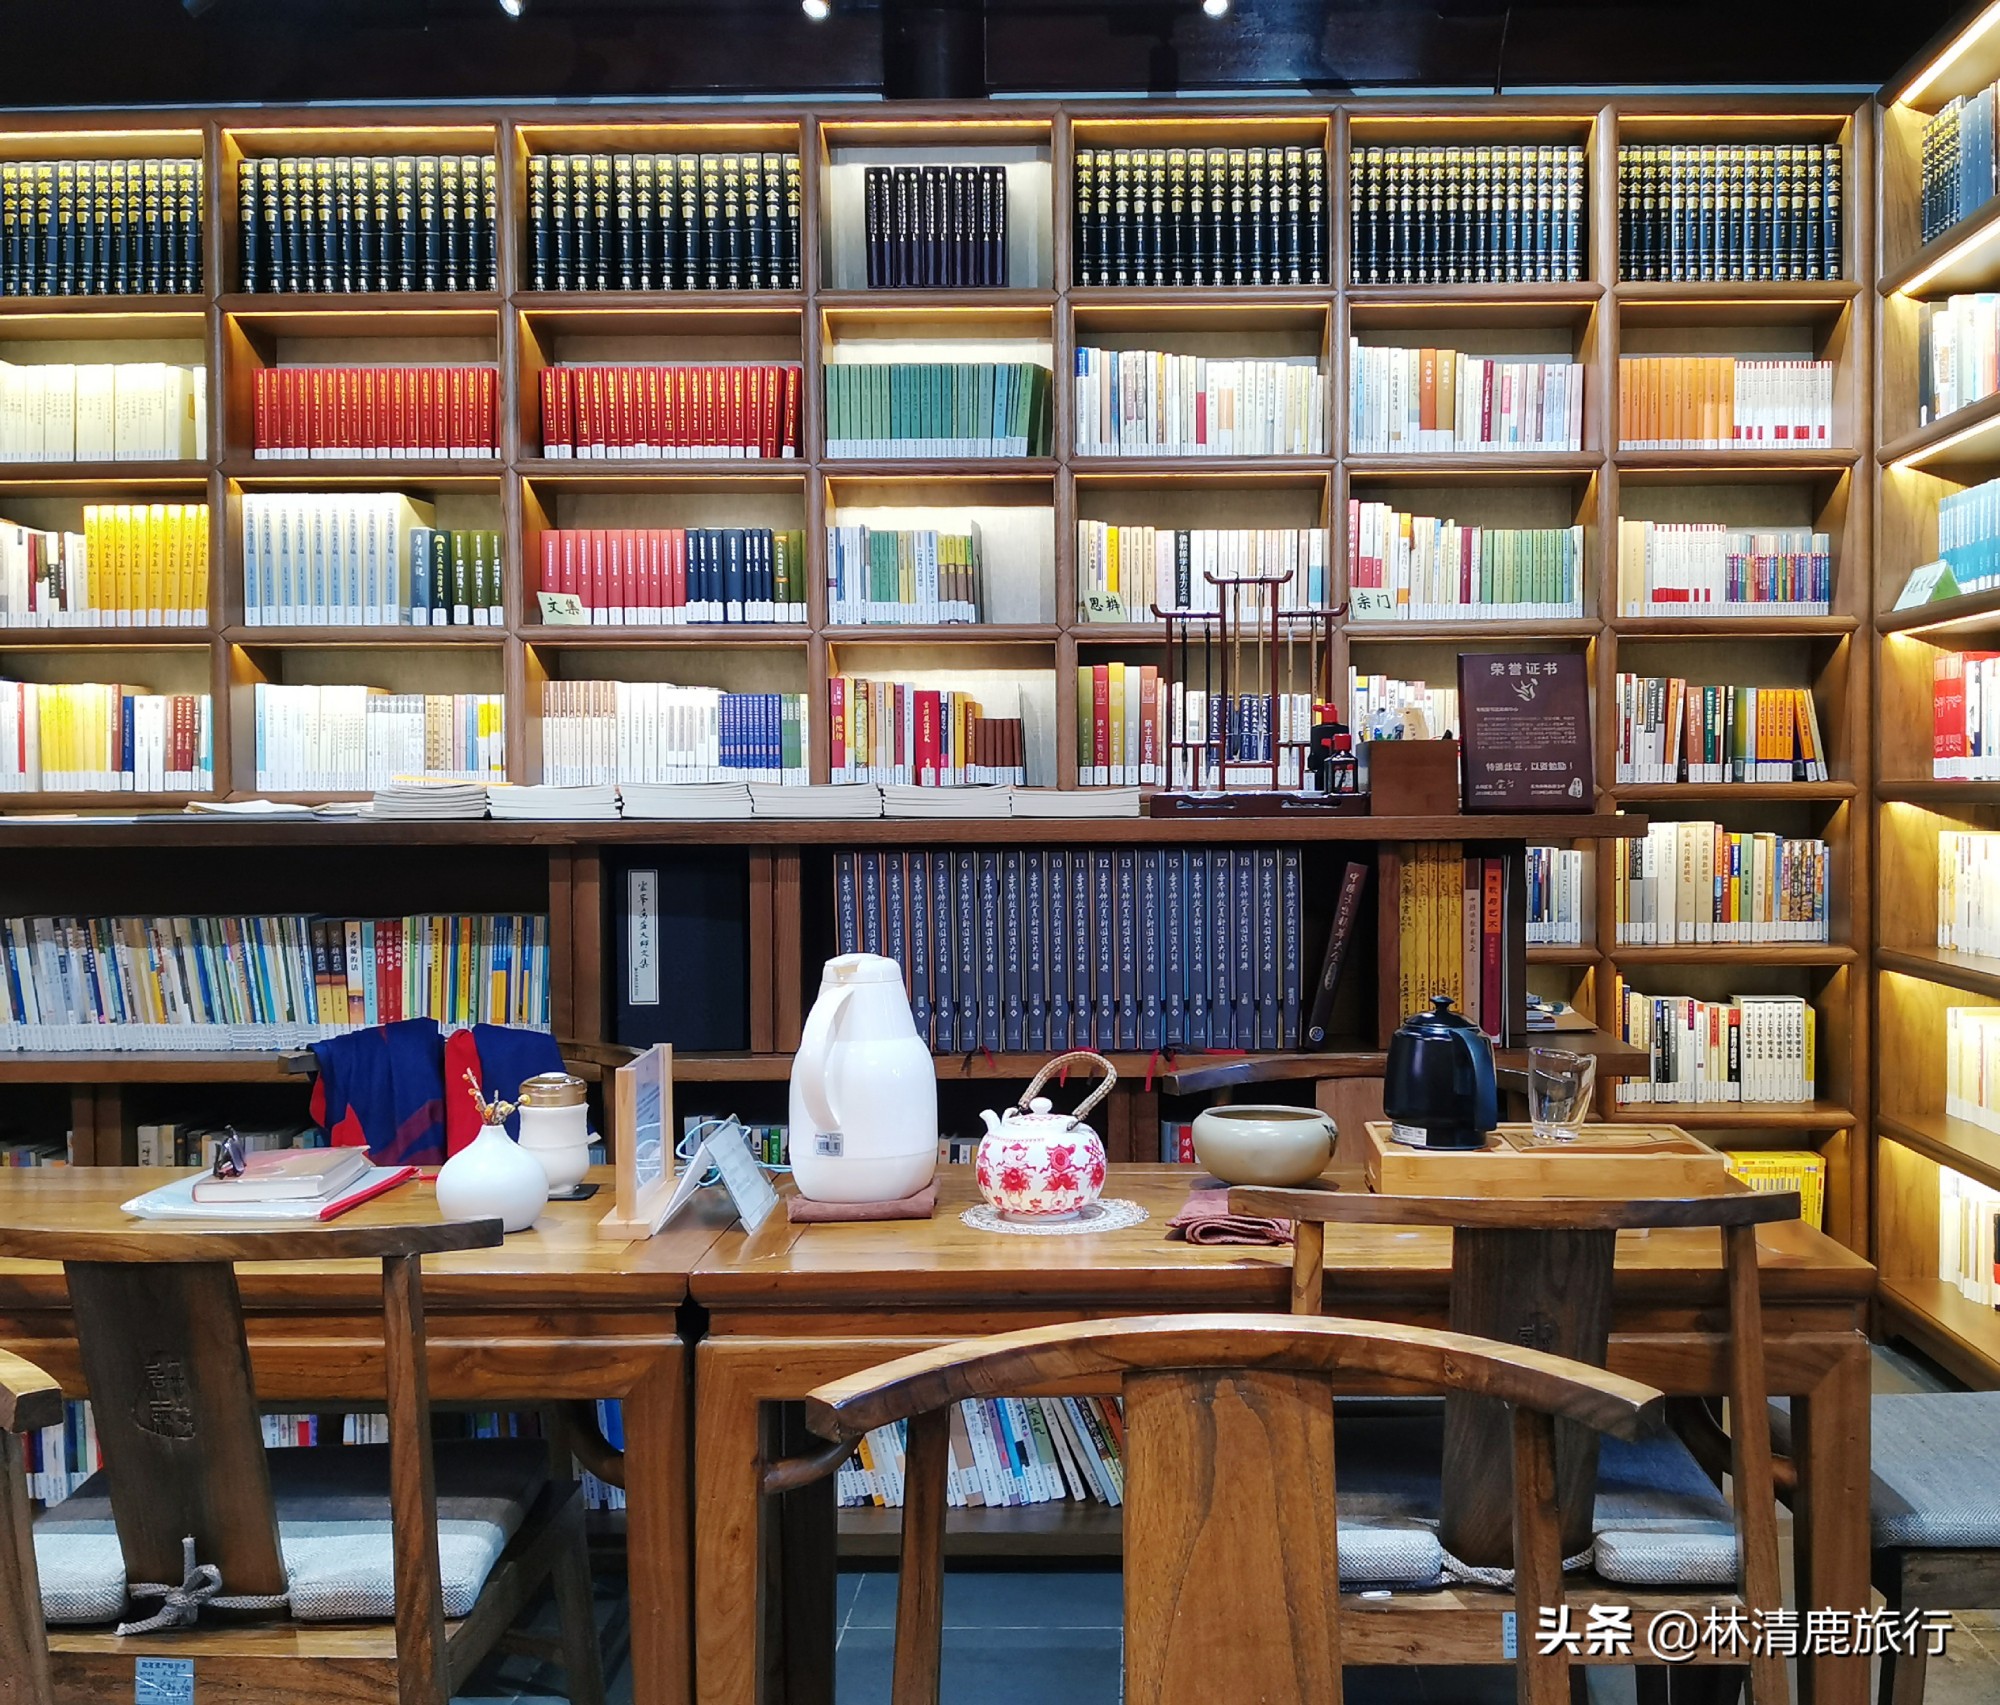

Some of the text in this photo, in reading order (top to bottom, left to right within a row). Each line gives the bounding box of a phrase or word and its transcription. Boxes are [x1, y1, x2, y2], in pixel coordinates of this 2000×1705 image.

[1089, 596, 1120, 614] 思辨
[1357, 592, 1392, 610] 宗门
[547, 597, 580, 615] 文集
[1490, 662, 1558, 676] 荣誉证书
[844, 861, 848, 870] 1
[868, 861, 874, 869] 2
[892, 860, 898, 869] 3
[914, 860, 920, 869] 4
[938, 860, 944, 869] 5
[962, 860, 968, 868] 6
[984, 860, 990, 868] 7
[1008, 860, 1014, 868] 8
[1031, 859, 1036, 867] 9
[1052, 859, 1062, 868] 10
[1076, 859, 1084, 867] 11
[1100, 859, 1108, 868] 12
[1121, 859, 1131, 868] 13
[1146, 859, 1154, 868] 14
[1168, 858, 1178, 867] 15
[1192, 858, 1202, 866] 16
[1216, 858, 1226, 866] 17
[1240, 857, 1249, 866] 18
[1262, 858, 1272, 866] 19
[1286, 858, 1296, 866] 20
